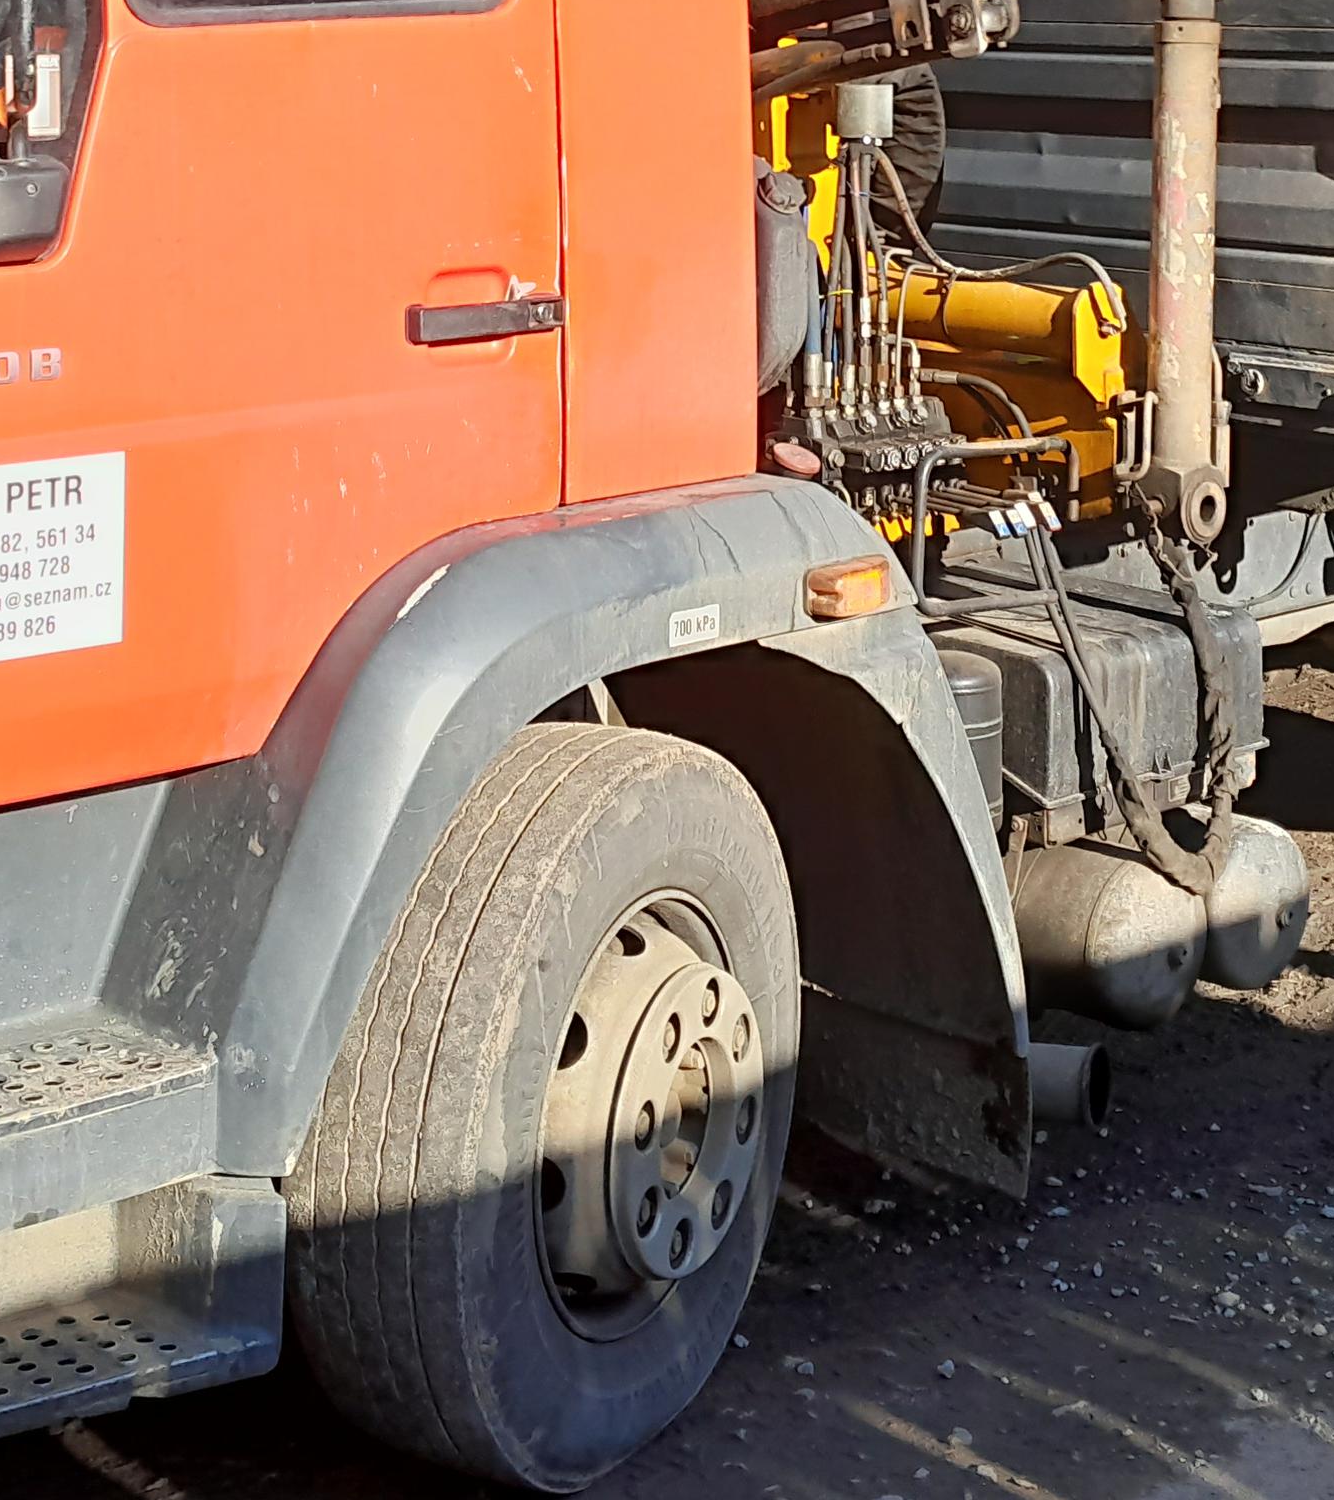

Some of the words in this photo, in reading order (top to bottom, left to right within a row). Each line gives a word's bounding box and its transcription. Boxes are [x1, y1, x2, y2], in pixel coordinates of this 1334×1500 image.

[29, 347, 63, 382] B
[5, 473, 84, 514] PETR
[0, 533, 30, 554] 82,
[36, 527, 67, 549] 561
[74, 522, 97, 544] 34
[39, 555, 71, 577] 728
[23, 615, 57, 638] 826
[672, 617, 693, 637] 700
[695, 612, 717, 634] kPa
